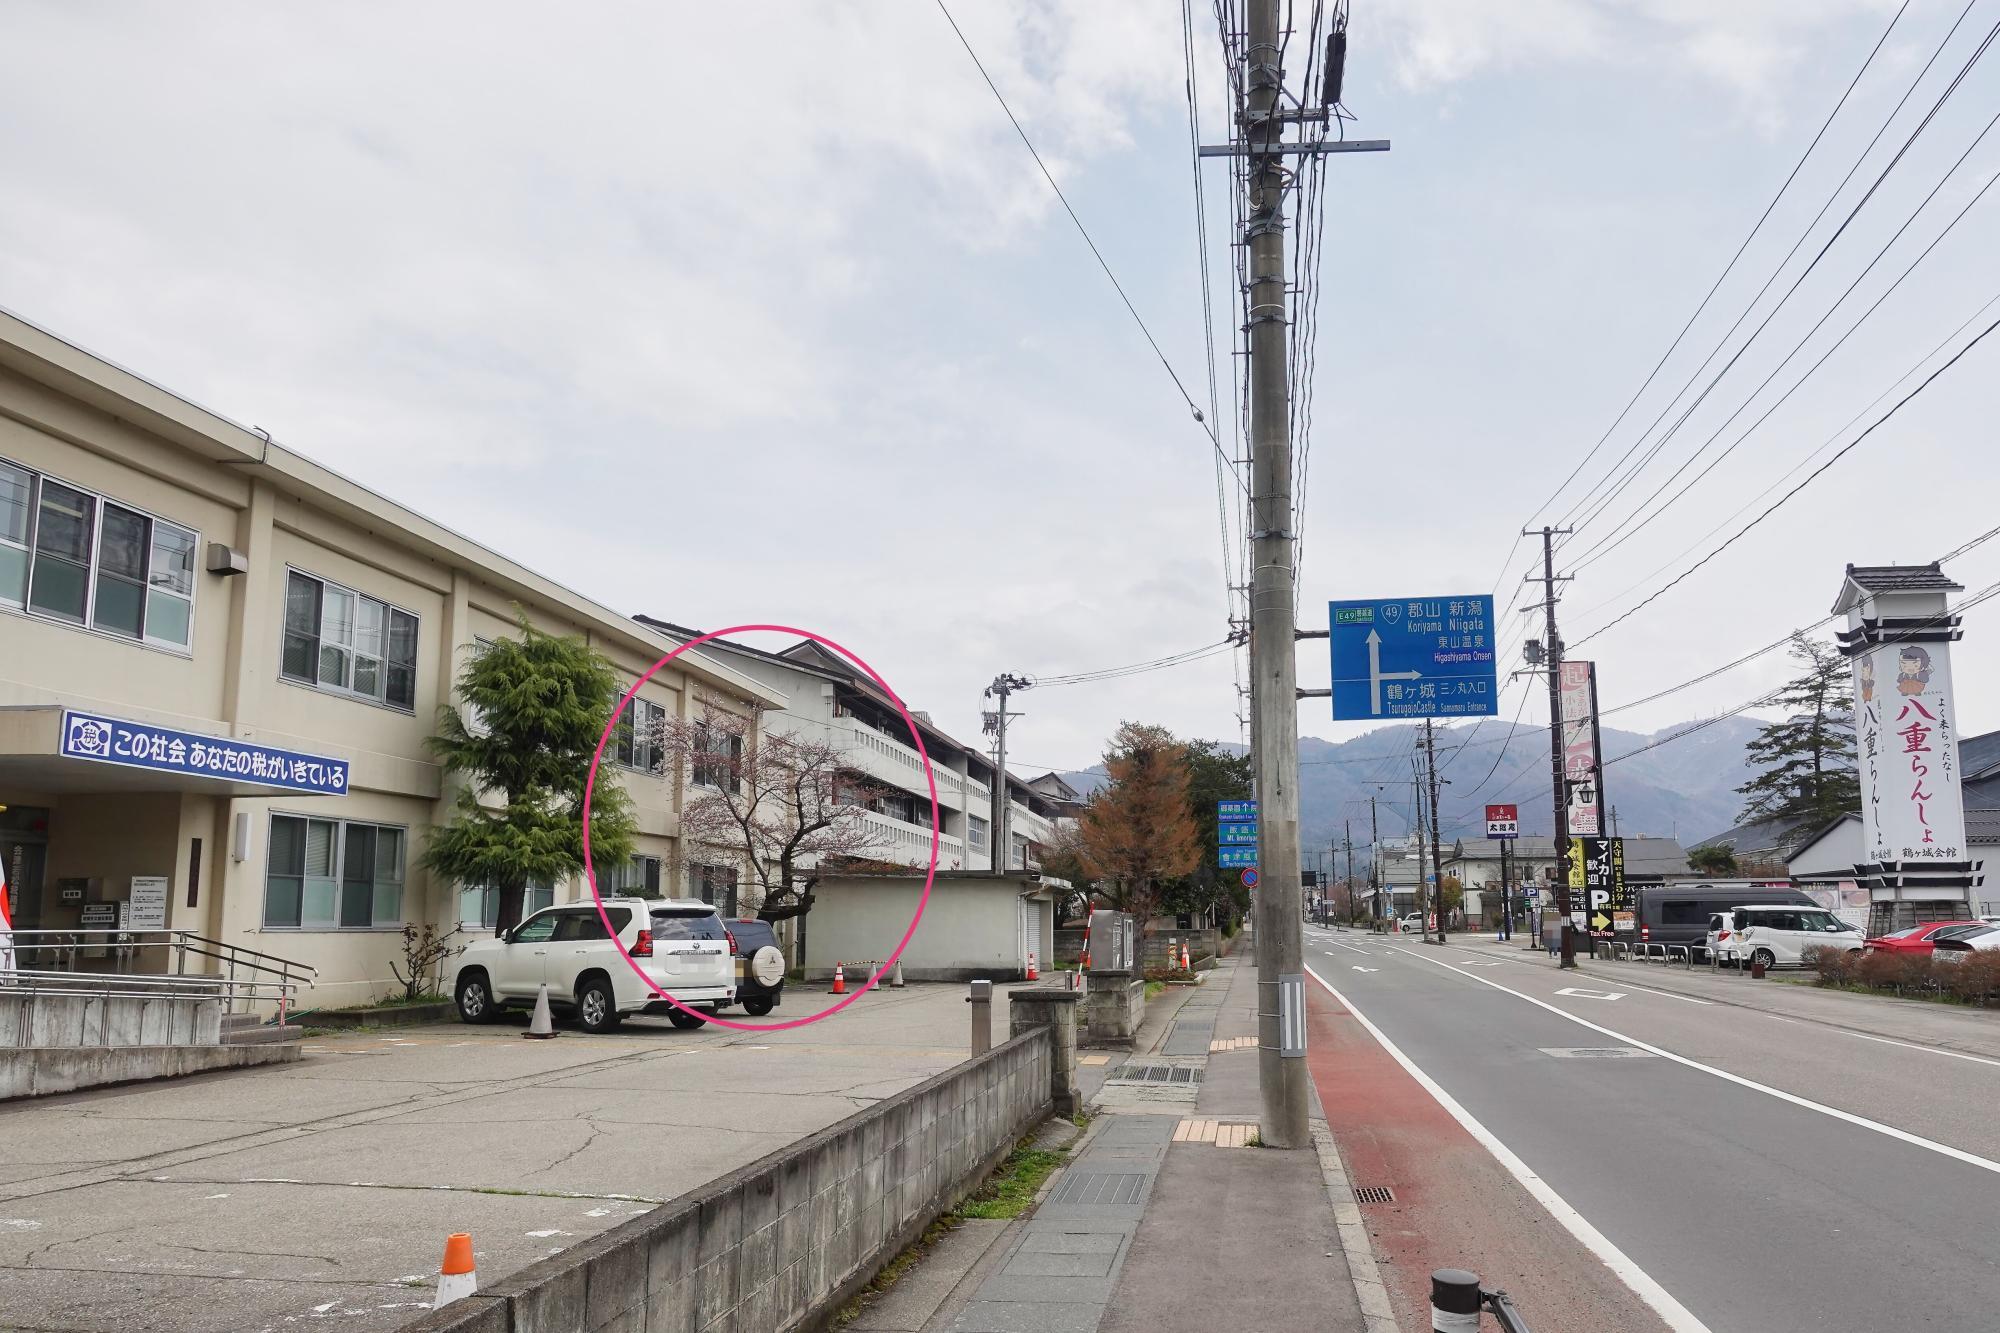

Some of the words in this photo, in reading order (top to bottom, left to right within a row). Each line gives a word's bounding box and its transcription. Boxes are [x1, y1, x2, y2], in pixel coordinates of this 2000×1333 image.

[1385, 606, 1398, 618] 49
[1408, 602, 1440, 618] 郡山
[1449, 600, 1482, 616] 新潟
[1407, 620, 1442, 635] Koriyama
[1449, 617, 1484, 633] Niigata
[1438, 635, 1484, 649] 東山温泉
[1434, 651, 1472, 664] Higashiyama
[1472, 651, 1492, 661] Onsen
[1467, 701, 1487, 712] Entrance
[114, 729, 186, 766] この社会
[189, 741, 345, 788] あなたの税がいきている
[1862, 705, 1883, 845] 八重らんしょ
[1896, 698, 1937, 843] 八重らんしょ
[1586, 859, 1600, 885] 歓迎
[1596, 840, 1610, 886] マイカー
[1528, 888, 1537, 897] P
[1590, 889, 1610, 910] P
